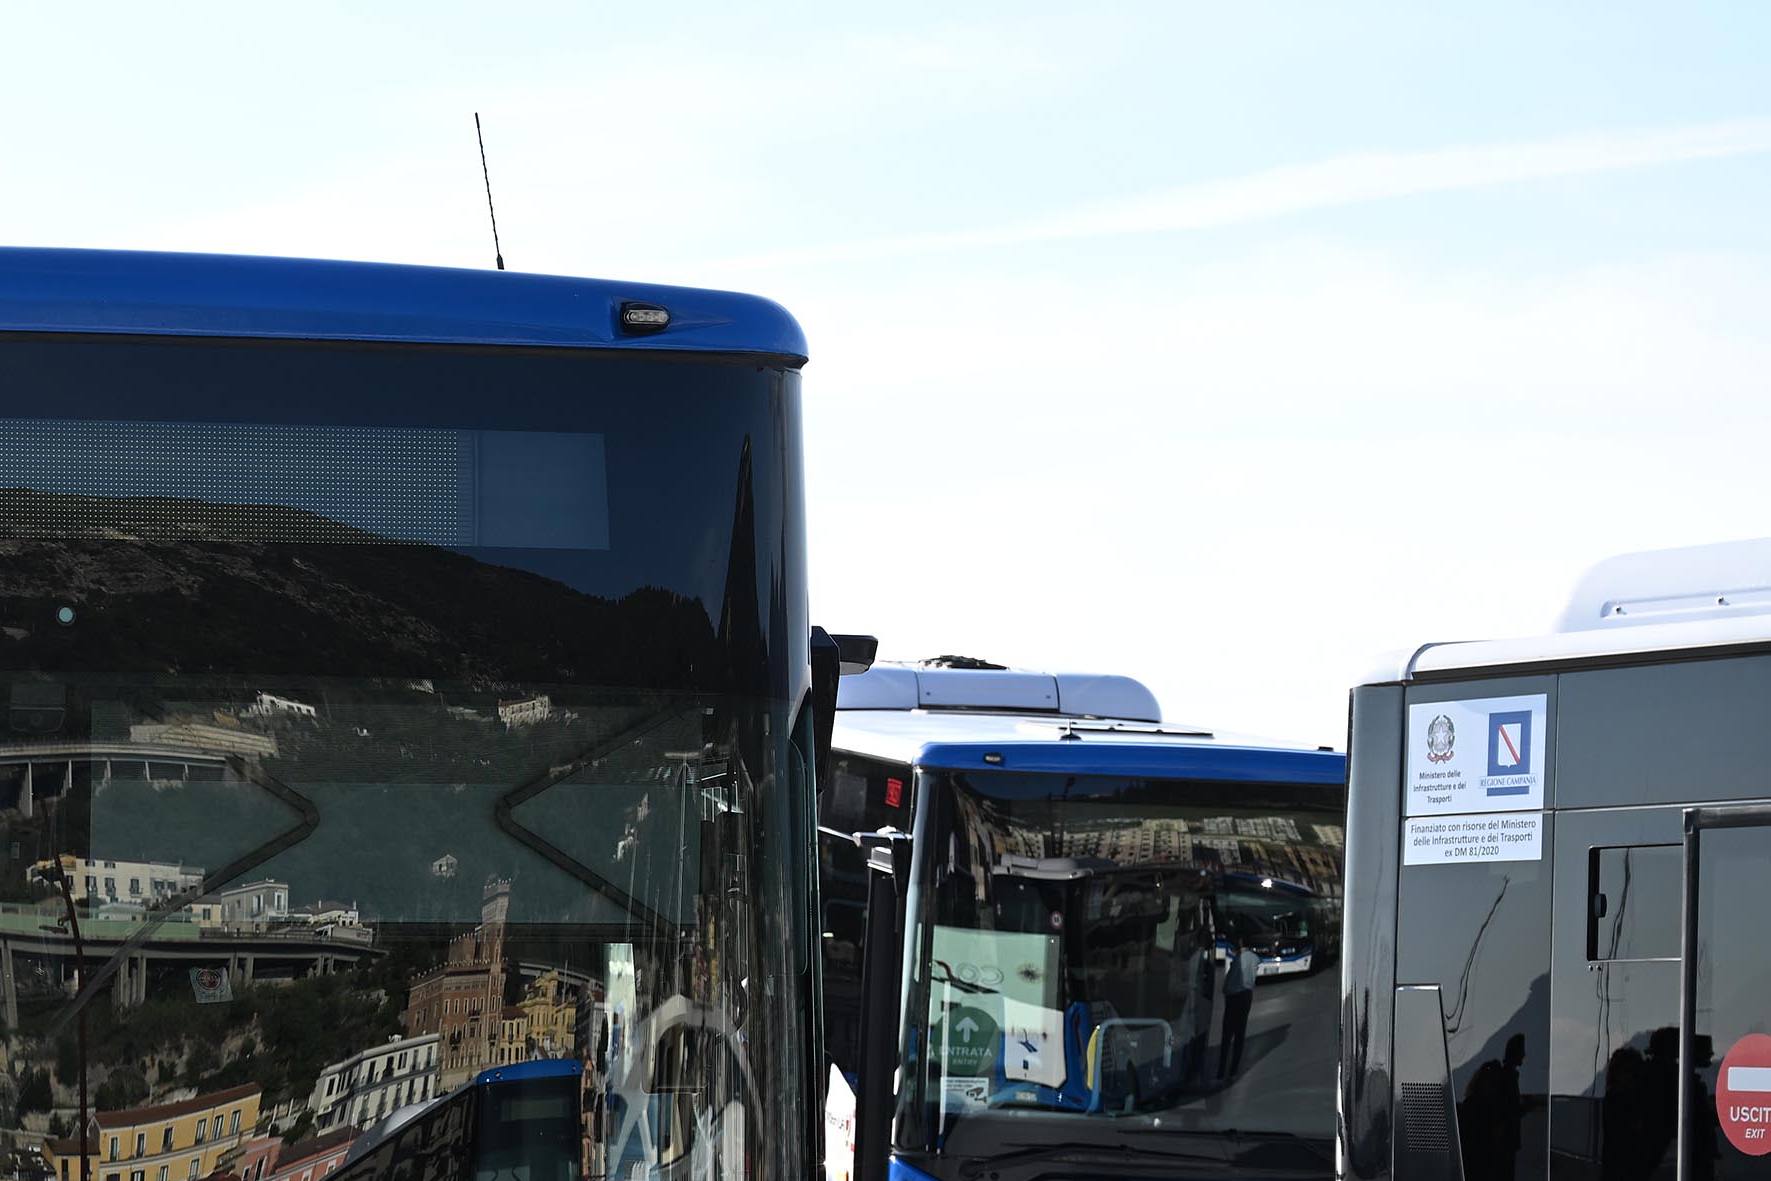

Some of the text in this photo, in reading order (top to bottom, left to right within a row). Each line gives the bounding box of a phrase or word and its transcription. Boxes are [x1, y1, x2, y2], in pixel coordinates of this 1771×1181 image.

[1419, 769, 1461, 780] Ministero delle
[1413, 782, 1452, 792] Infrastrutture
[1457, 781, 1467, 790] dei
[1480, 775, 1537, 787] REGIONE CAMPANIA
[1427, 794, 1452, 805] Trasporti
[1411, 819, 1536, 834] Finanziato con risorse del Ministero
[1413, 836, 1431, 847] delle
[1432, 834, 1480, 845] Infrastrutture
[1487, 833, 1499, 843] dei
[1500, 831, 1533, 844] Trasporti
[1444, 846, 1499, 858] ex DM 81/2020
[1730, 1105, 1771, 1123] USCIT
[1745, 1128, 1766, 1139] EXIT
